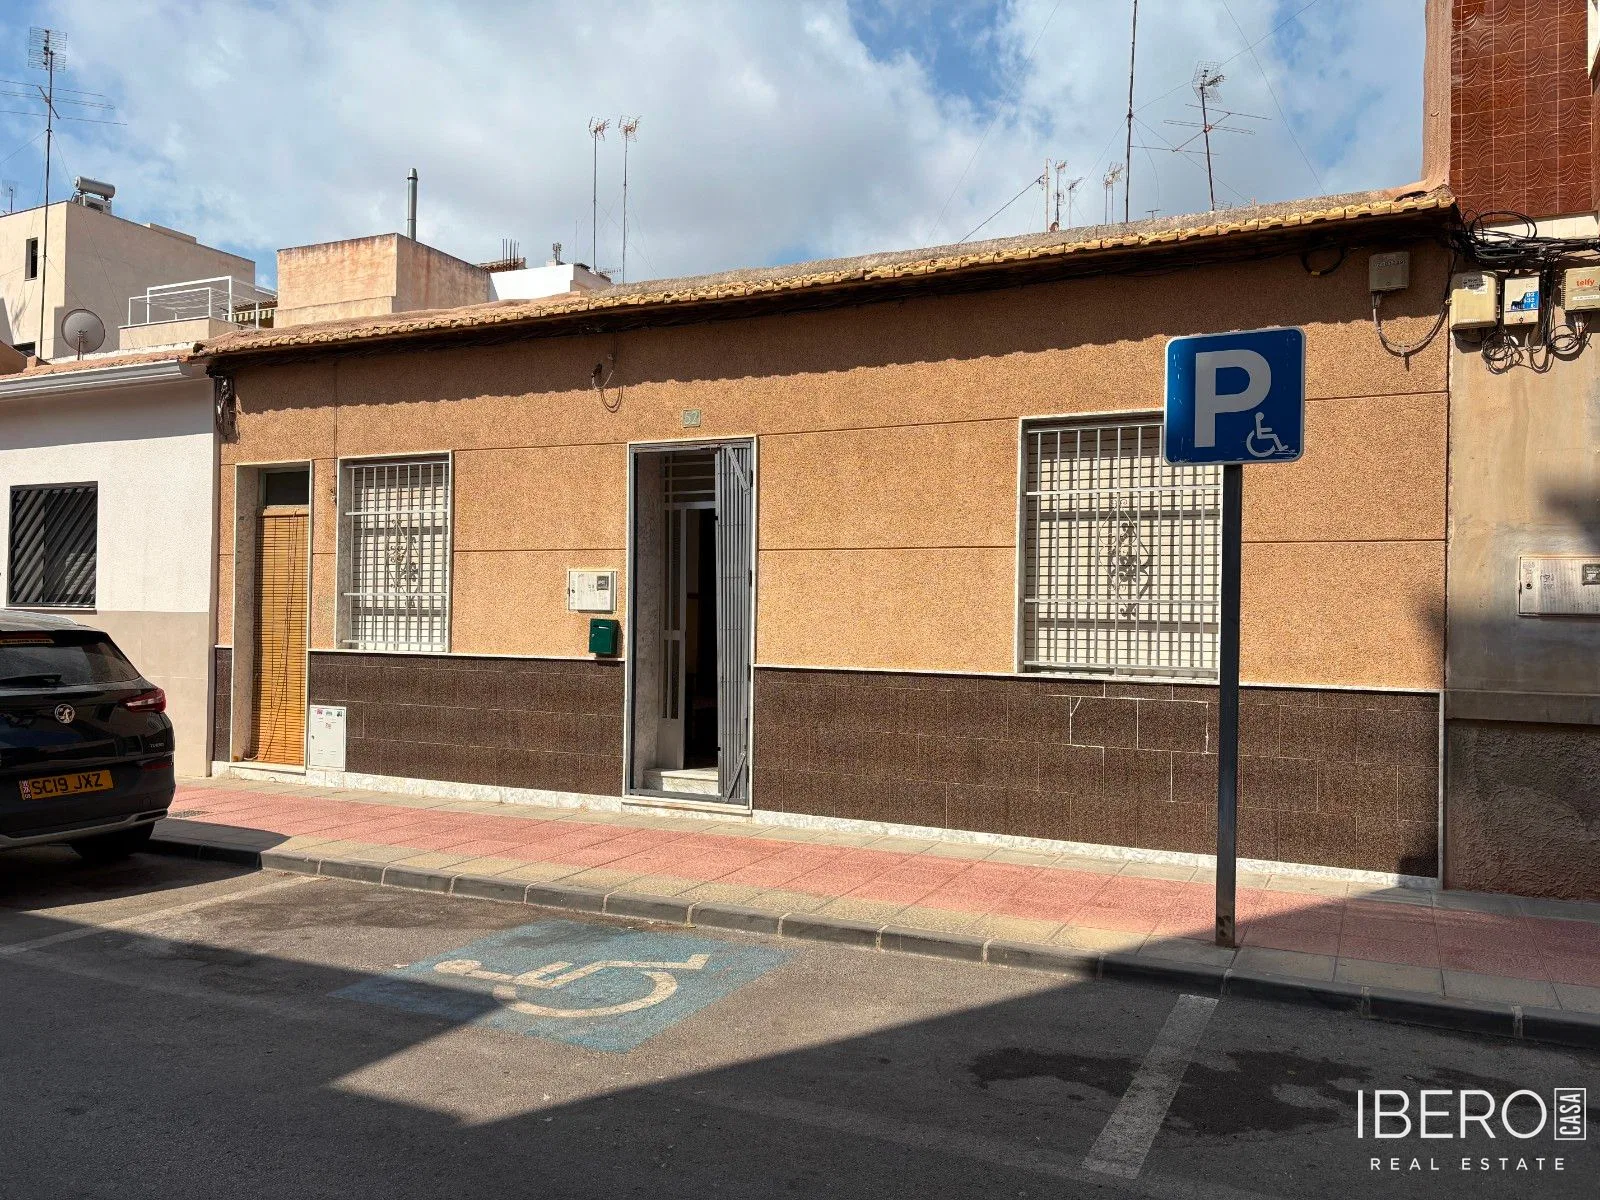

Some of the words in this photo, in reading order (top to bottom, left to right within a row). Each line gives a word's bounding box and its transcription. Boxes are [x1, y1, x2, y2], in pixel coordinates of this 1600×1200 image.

[1576, 278, 1595, 287] telfy
[1194, 349, 1272, 448] P
[31, 778, 69, 795] SC19
[74, 772, 104, 790] JXZ
